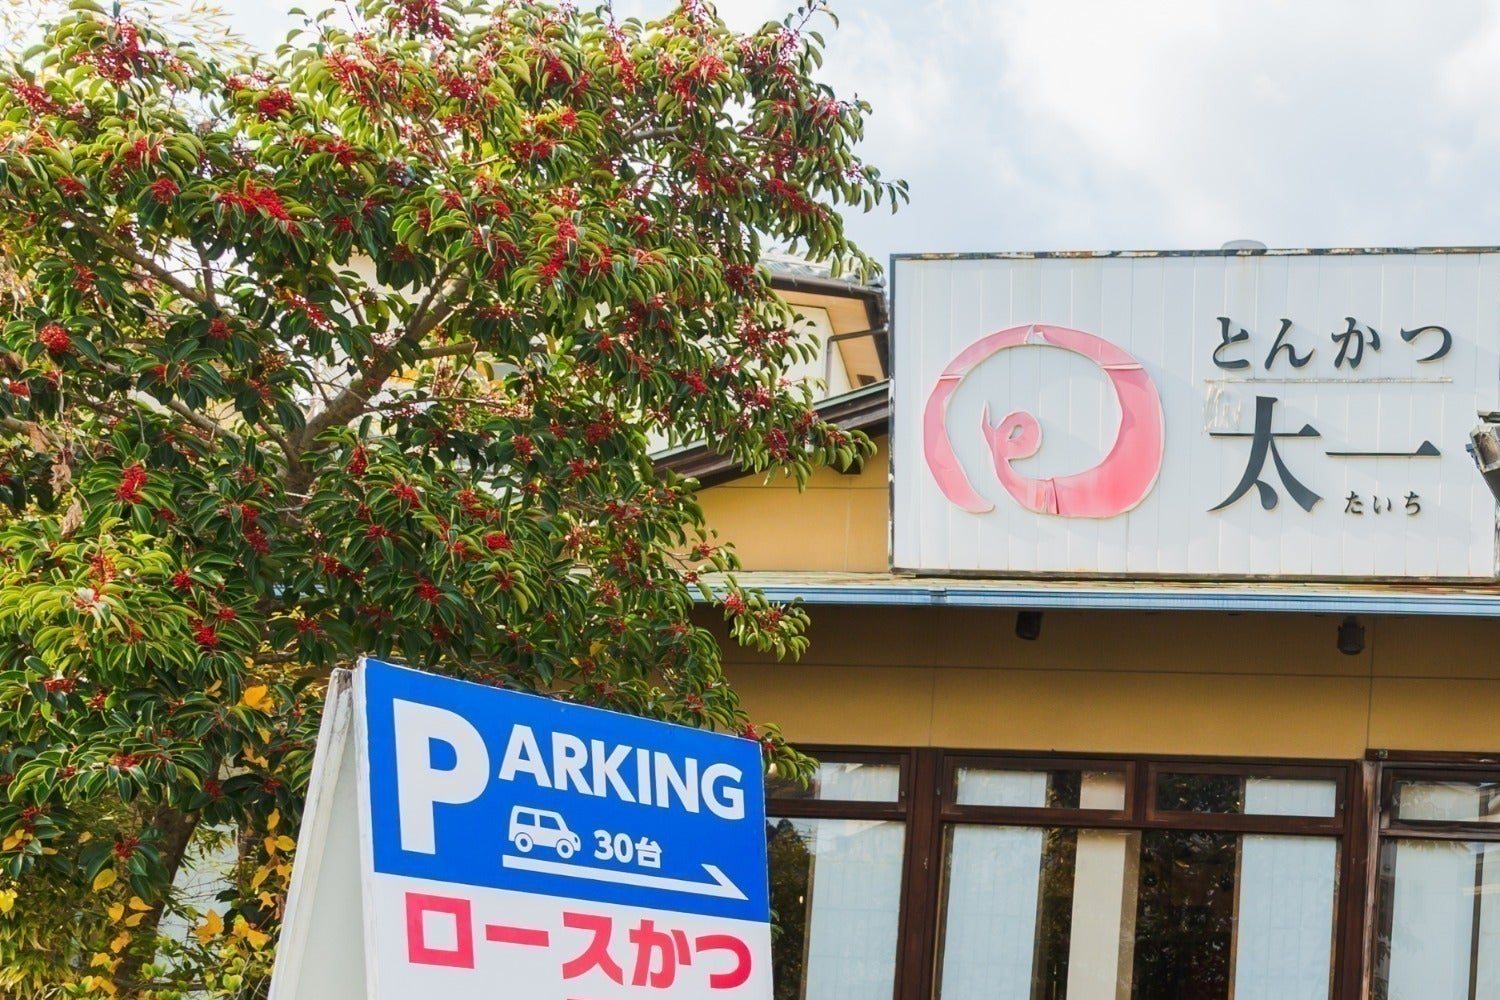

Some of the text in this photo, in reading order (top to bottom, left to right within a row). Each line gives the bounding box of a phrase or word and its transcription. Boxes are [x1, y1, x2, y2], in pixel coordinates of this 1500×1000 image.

[1212, 316, 1454, 370] とんかつ
[1206, 396, 1442, 512] 太一
[1343, 490, 1422, 516] たいち
[392, 698, 746, 855] PARKING
[593, 829, 663, 869] 30台
[405, 892, 752, 990] ロースかつ
